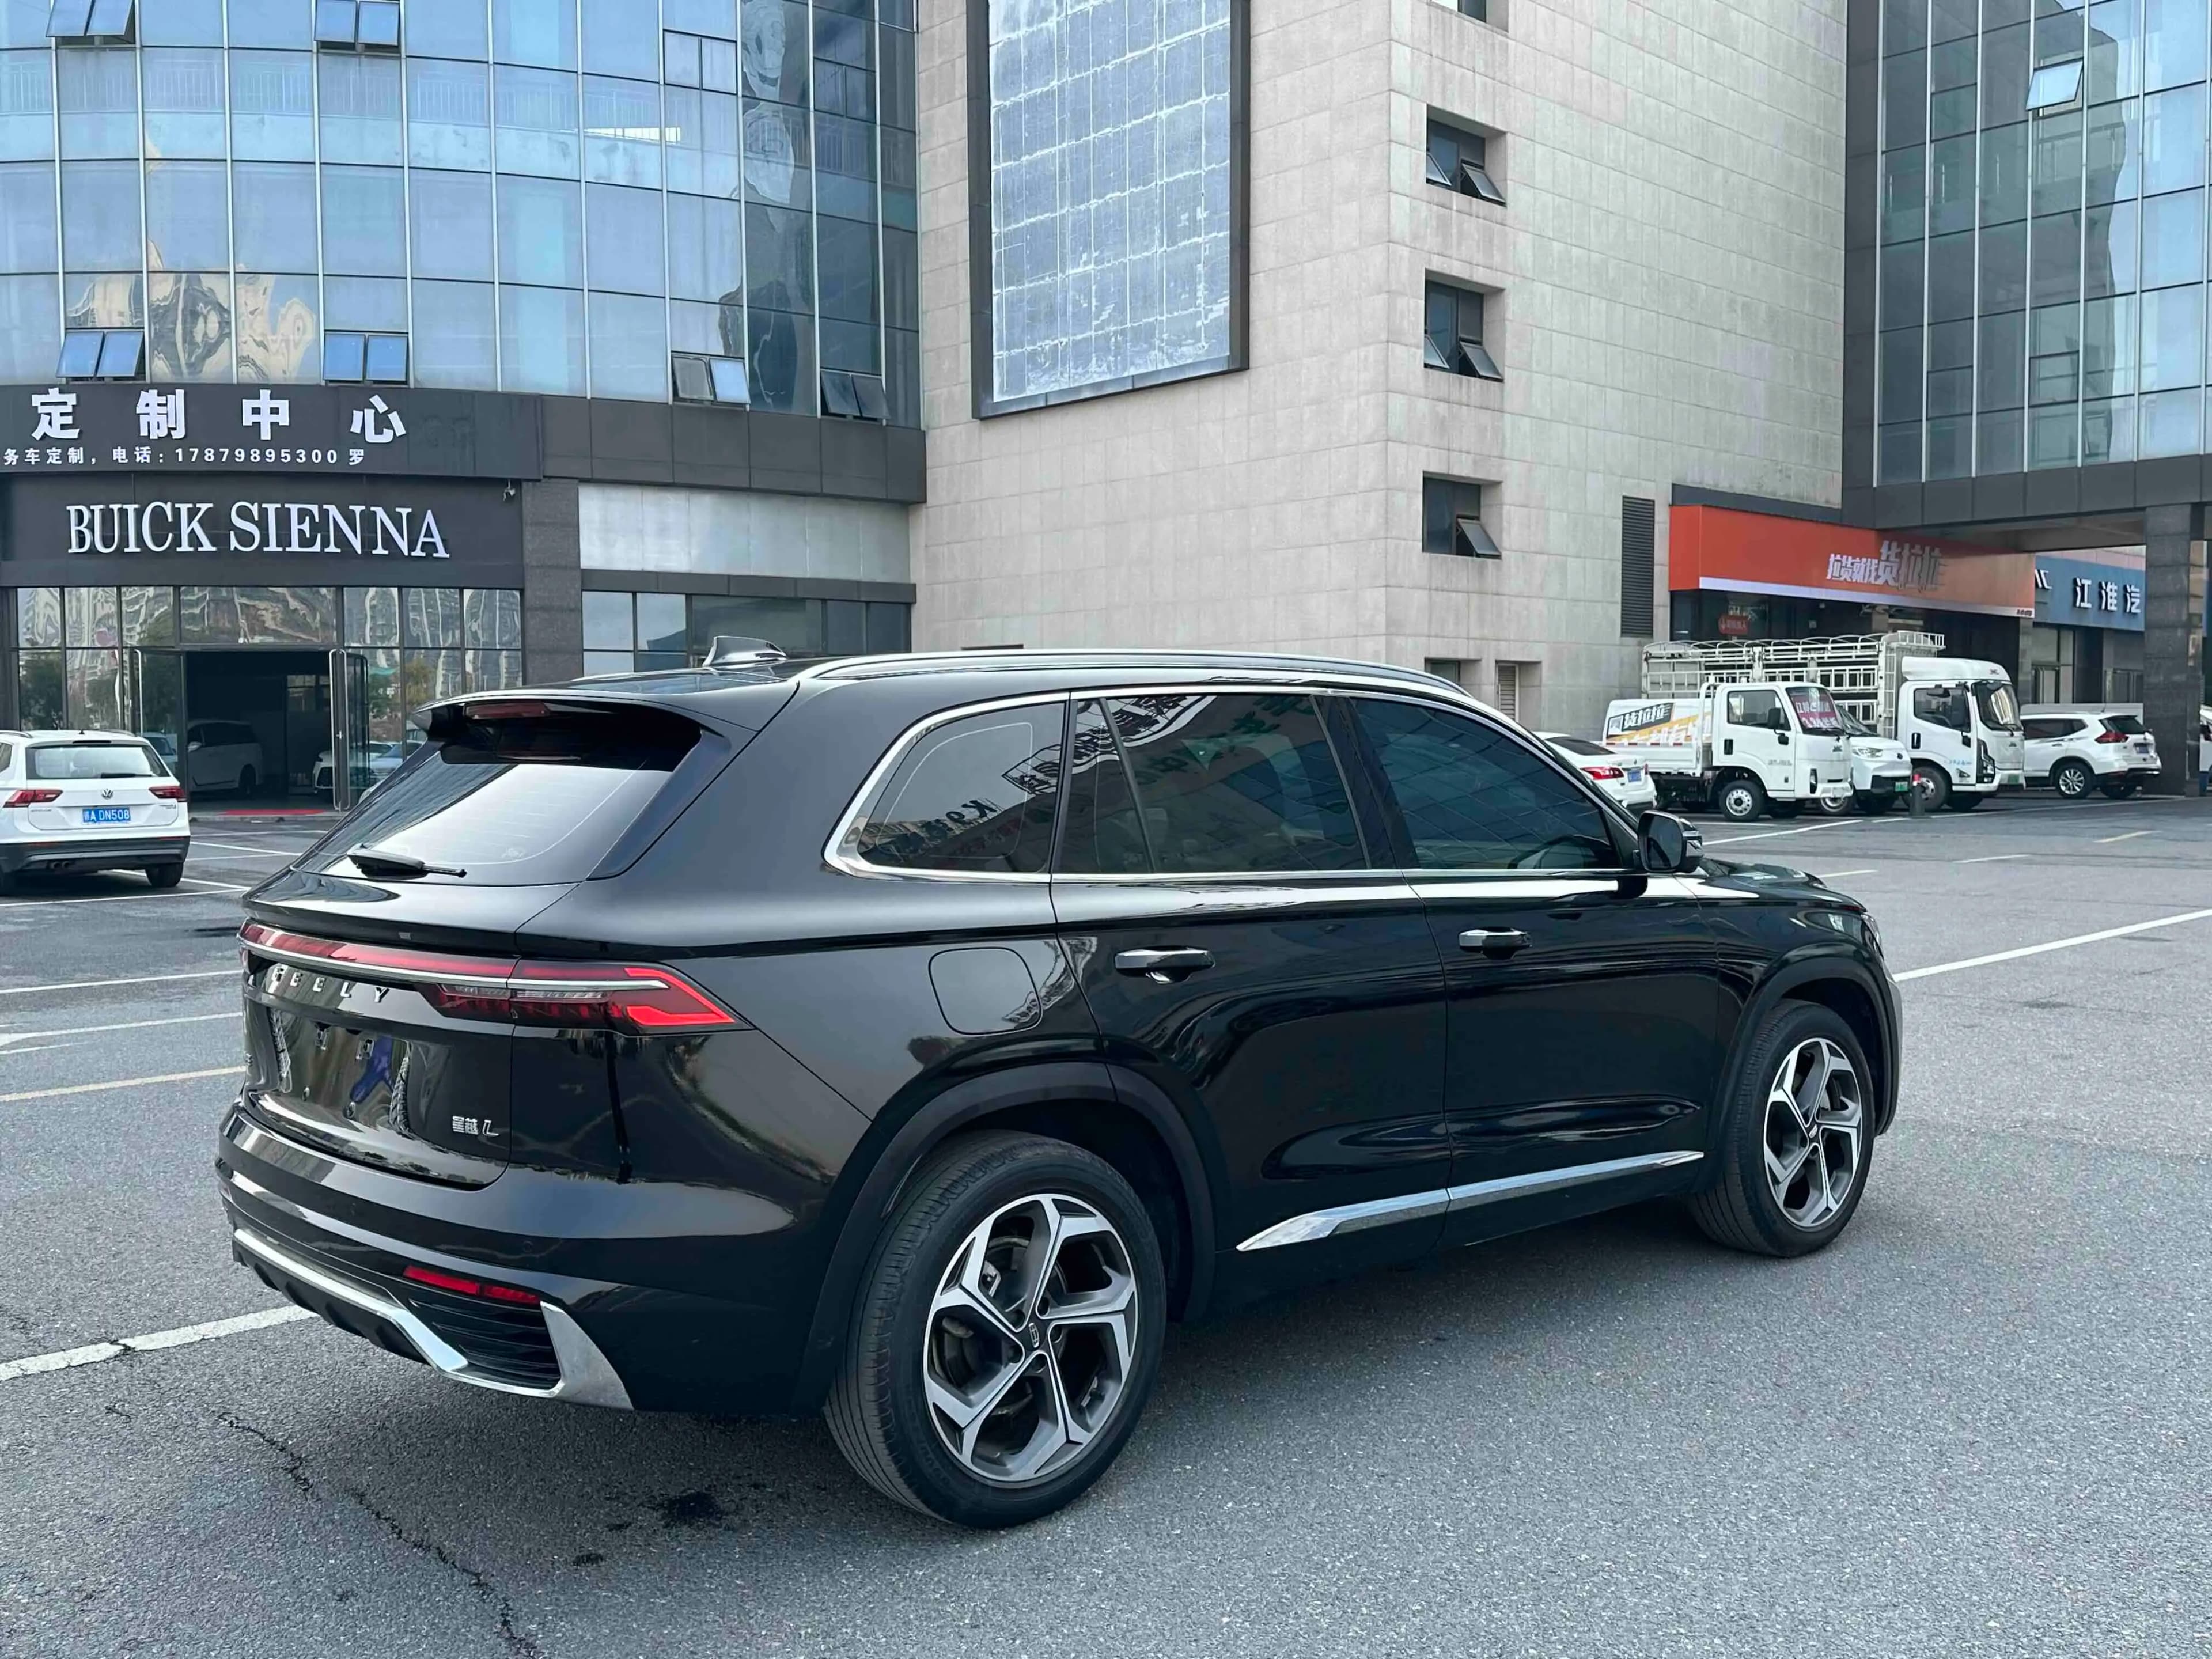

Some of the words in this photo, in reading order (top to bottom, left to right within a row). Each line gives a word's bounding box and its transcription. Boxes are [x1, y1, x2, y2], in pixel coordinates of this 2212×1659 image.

[31, 387, 406, 444] 定制中心
[66, 501, 217, 554] BUICK
[230, 501, 450, 558] SIENNA
[271, 967, 390, 1003] GEELY
